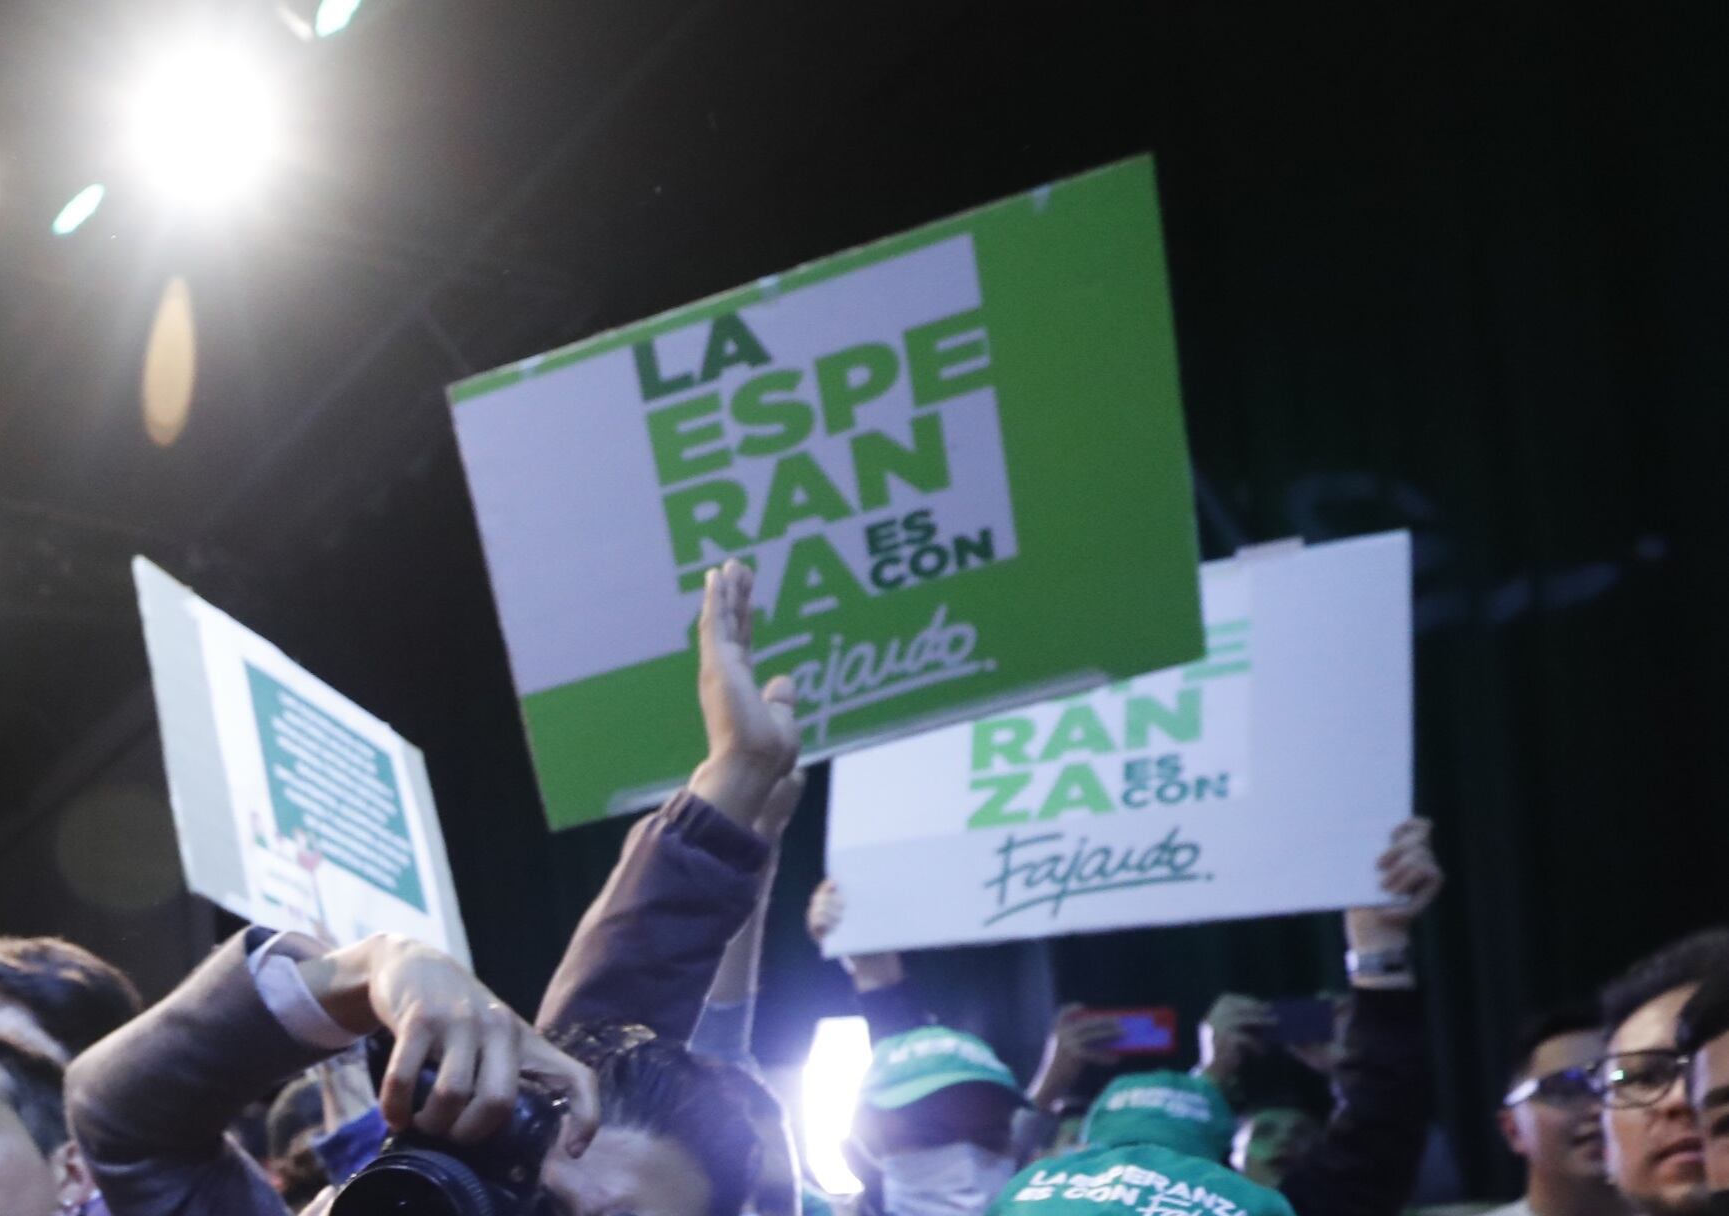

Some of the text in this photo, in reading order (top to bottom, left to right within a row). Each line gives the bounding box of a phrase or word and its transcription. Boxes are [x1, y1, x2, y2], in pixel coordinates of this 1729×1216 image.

[634, 312, 773, 402] LA
[646, 306, 992, 487] ESPE
[662, 411, 952, 568] RAN
[865, 508, 938, 557] ES
[869, 527, 995, 591] CON
[971, 686, 1204, 773] RAN
[966, 763, 1117, 831] ZA
[1122, 772, 1229, 810] CON
[1124, 753, 1182, 784] ES
[1062, 1183, 1142, 1207] CON
